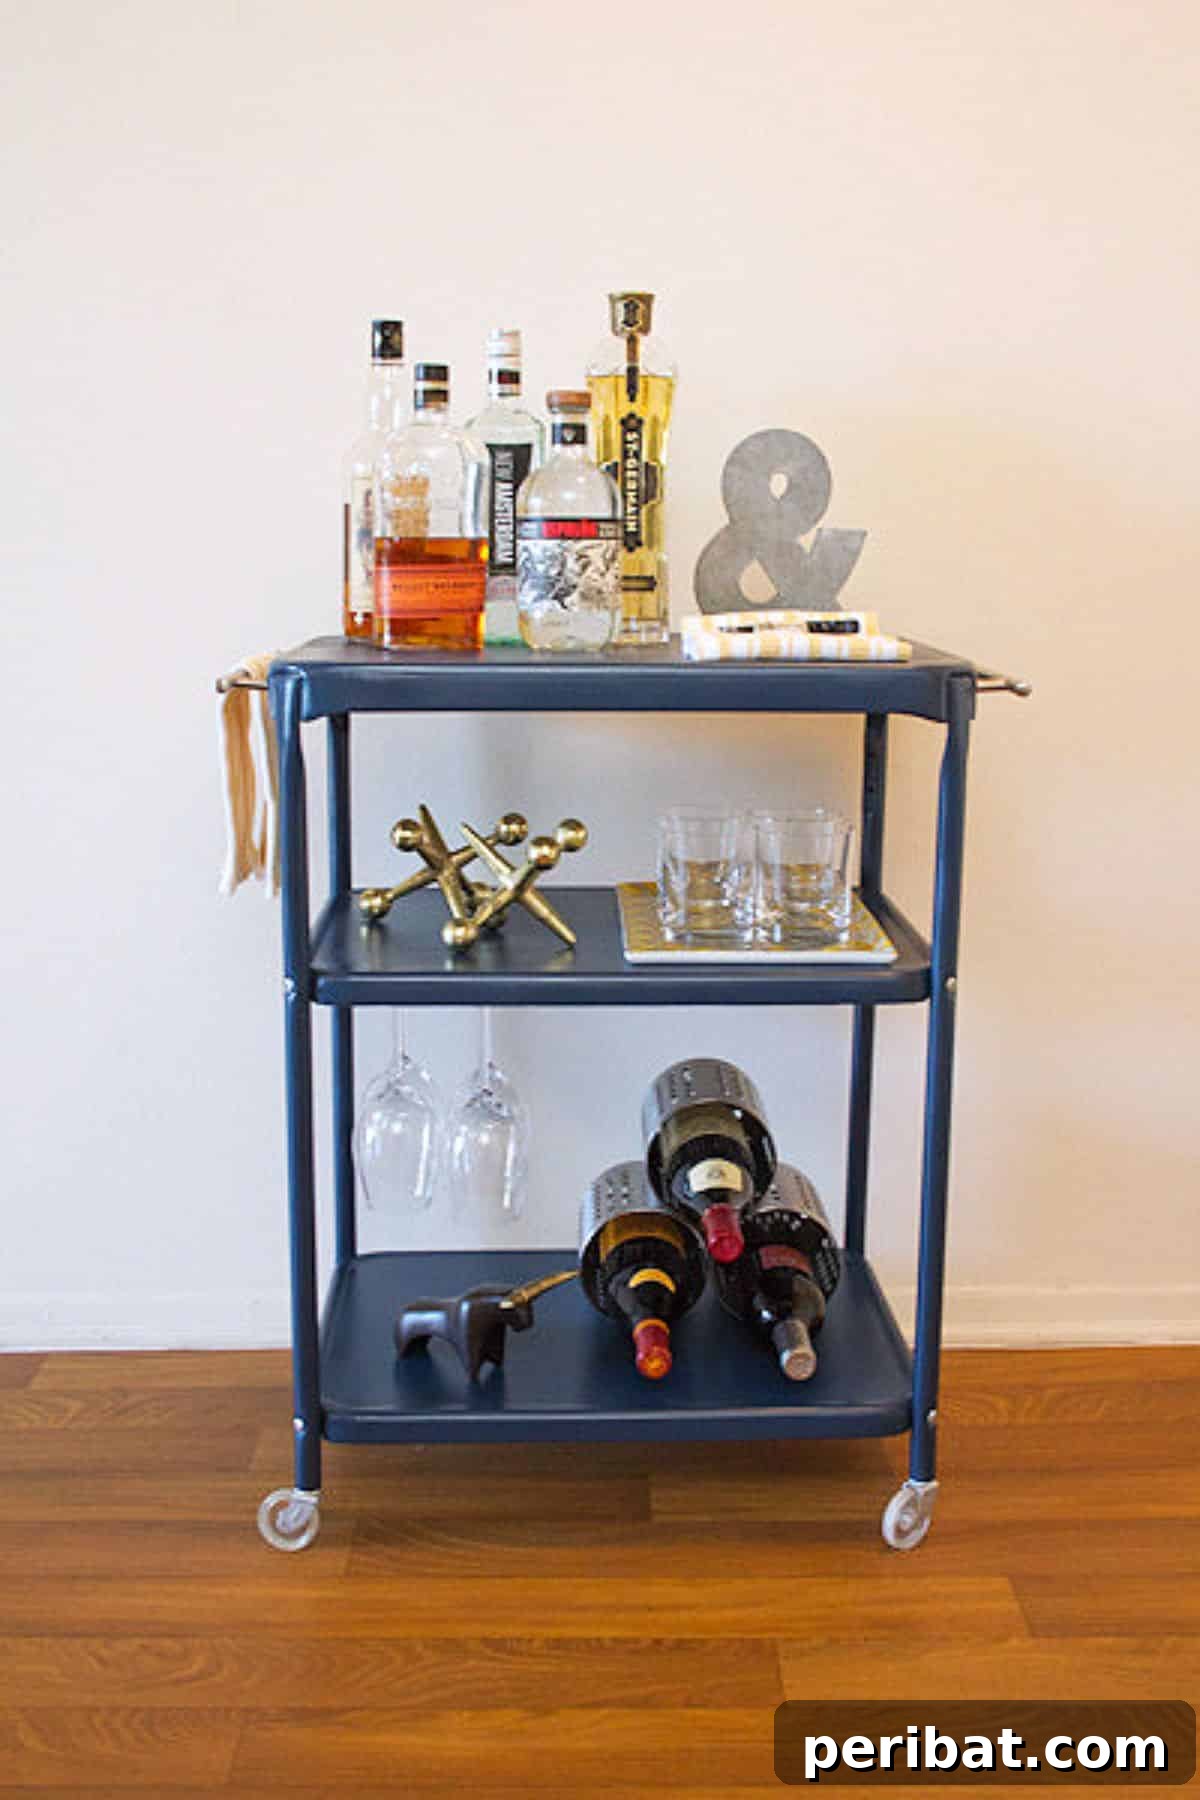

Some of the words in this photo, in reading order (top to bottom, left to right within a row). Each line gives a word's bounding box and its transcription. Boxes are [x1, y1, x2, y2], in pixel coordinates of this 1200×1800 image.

[495, 451, 514, 480] NEW
[495, 482, 514, 564] AMSTERDAM
[694, 429, 867, 614] &
